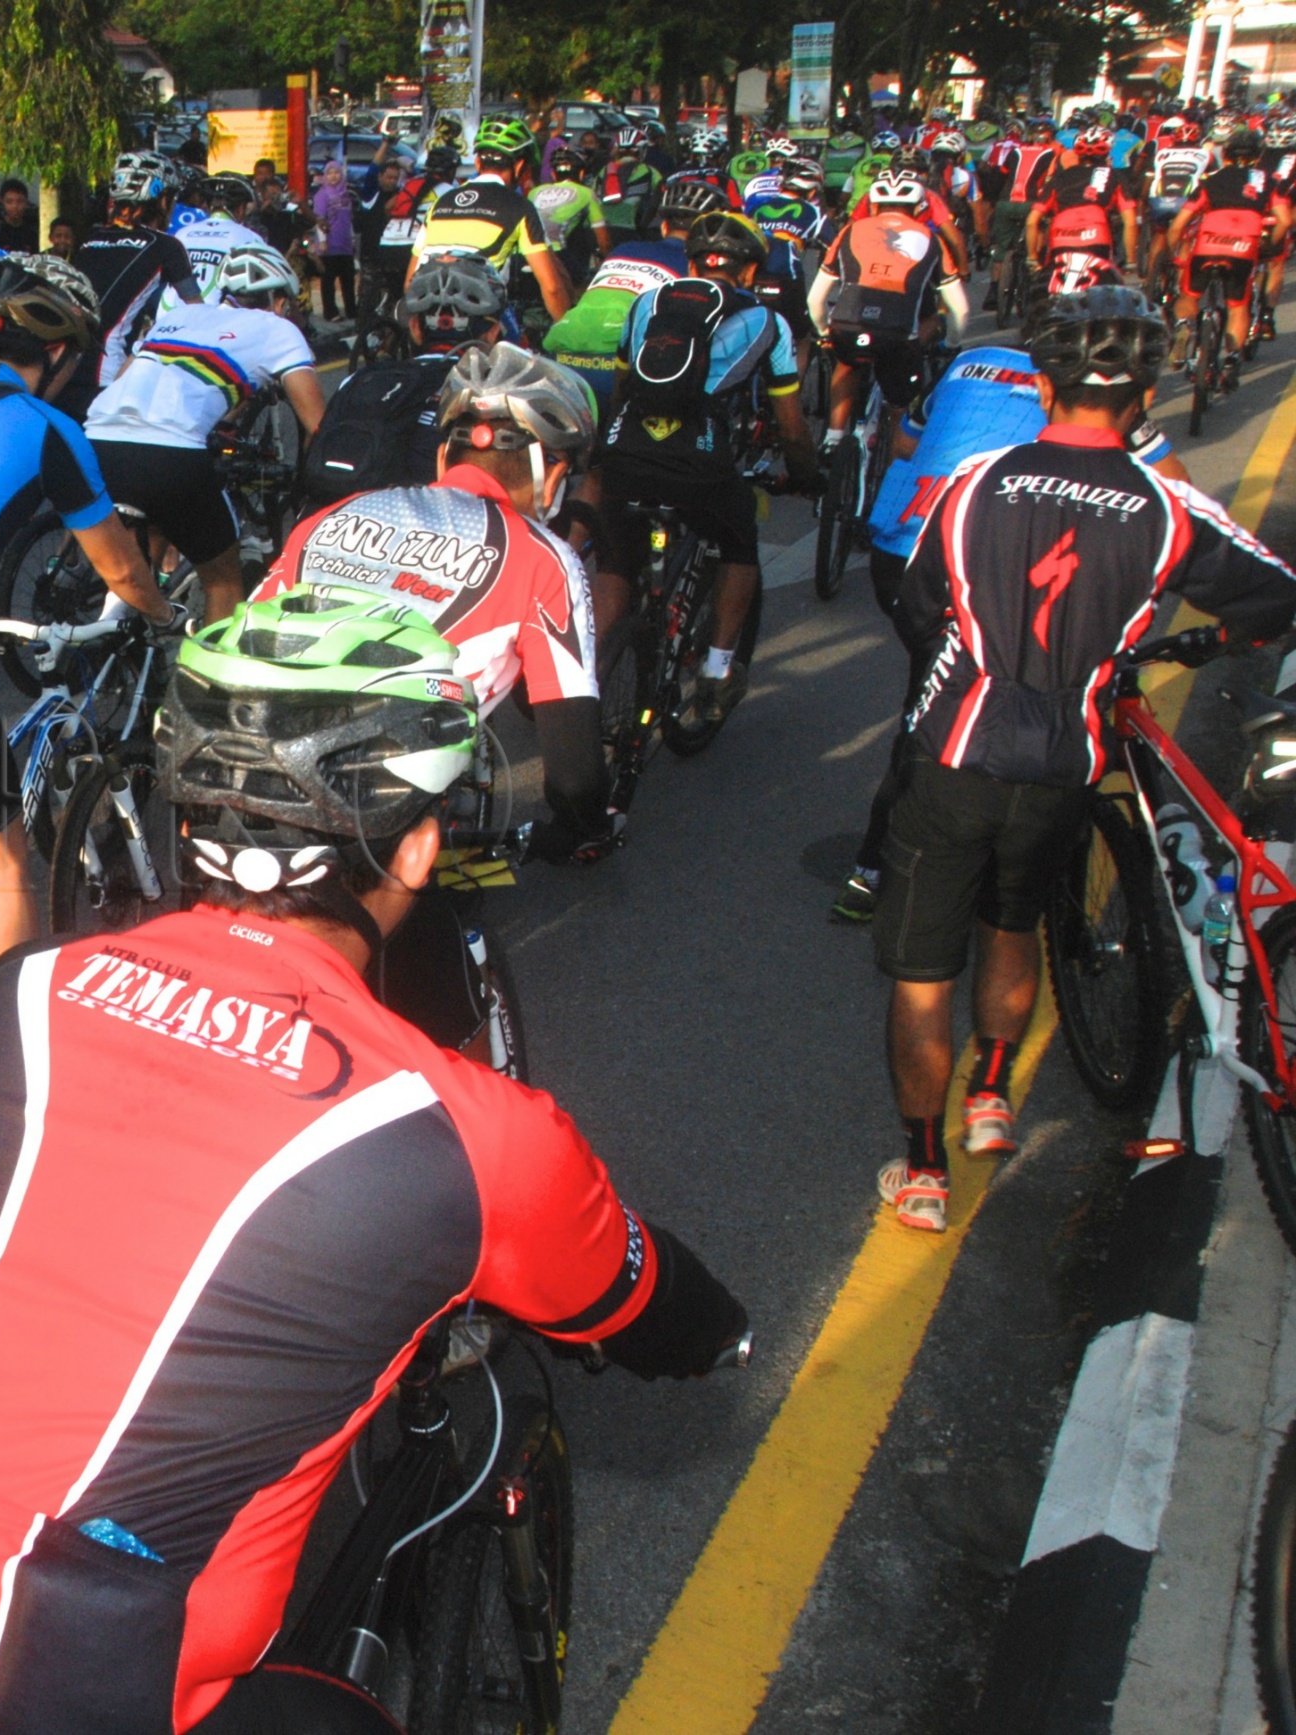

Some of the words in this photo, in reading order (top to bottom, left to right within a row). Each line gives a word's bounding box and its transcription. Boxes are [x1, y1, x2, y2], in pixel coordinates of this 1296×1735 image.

[607, 276, 645, 291] DCM
[995, 474, 1149, 514] SPECIALIZED
[1007, 493, 1130, 523] CYCLES
[306, 513, 397, 562] PEARL
[306, 552, 389, 586] Technical
[391, 570, 455, 604] Wear
[228, 923, 276, 947] ciclista
[101, 944, 140, 964] MTB
[141, 955, 193, 983] CLUB
[64, 952, 313, 1071] TEMASYA
